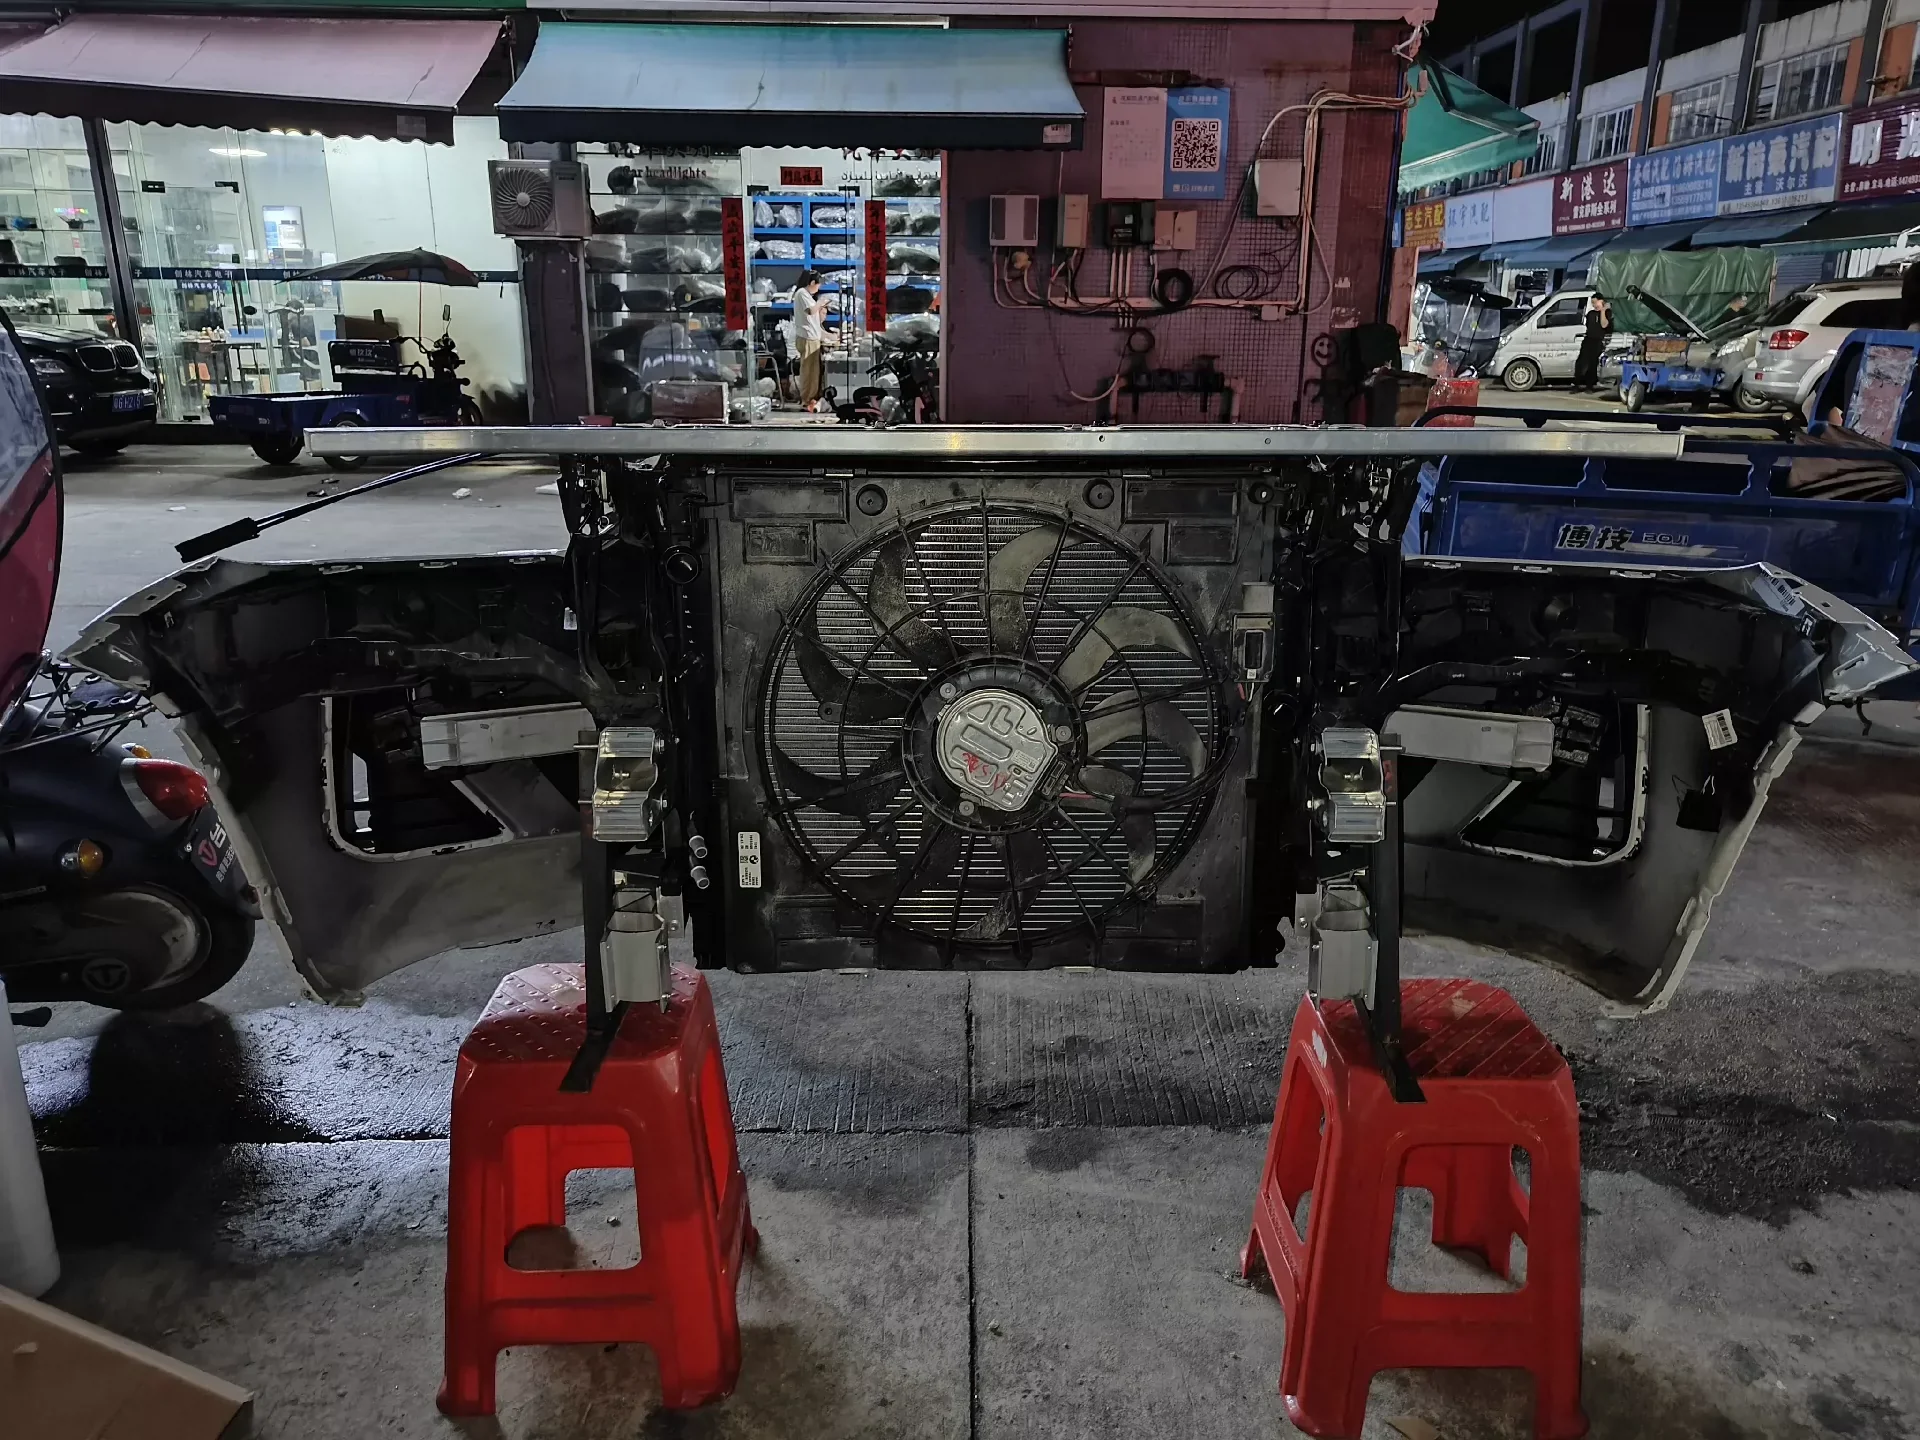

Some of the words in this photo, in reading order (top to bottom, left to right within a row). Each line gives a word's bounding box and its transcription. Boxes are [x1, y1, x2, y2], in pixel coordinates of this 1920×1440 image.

[622, 166, 643, 178] Car
[645, 166, 707, 179] headlights
[1560, 167, 1617, 203] 新港达
[1555, 523, 1634, 551] 博技
[1642, 532, 1689, 545] BOJI
